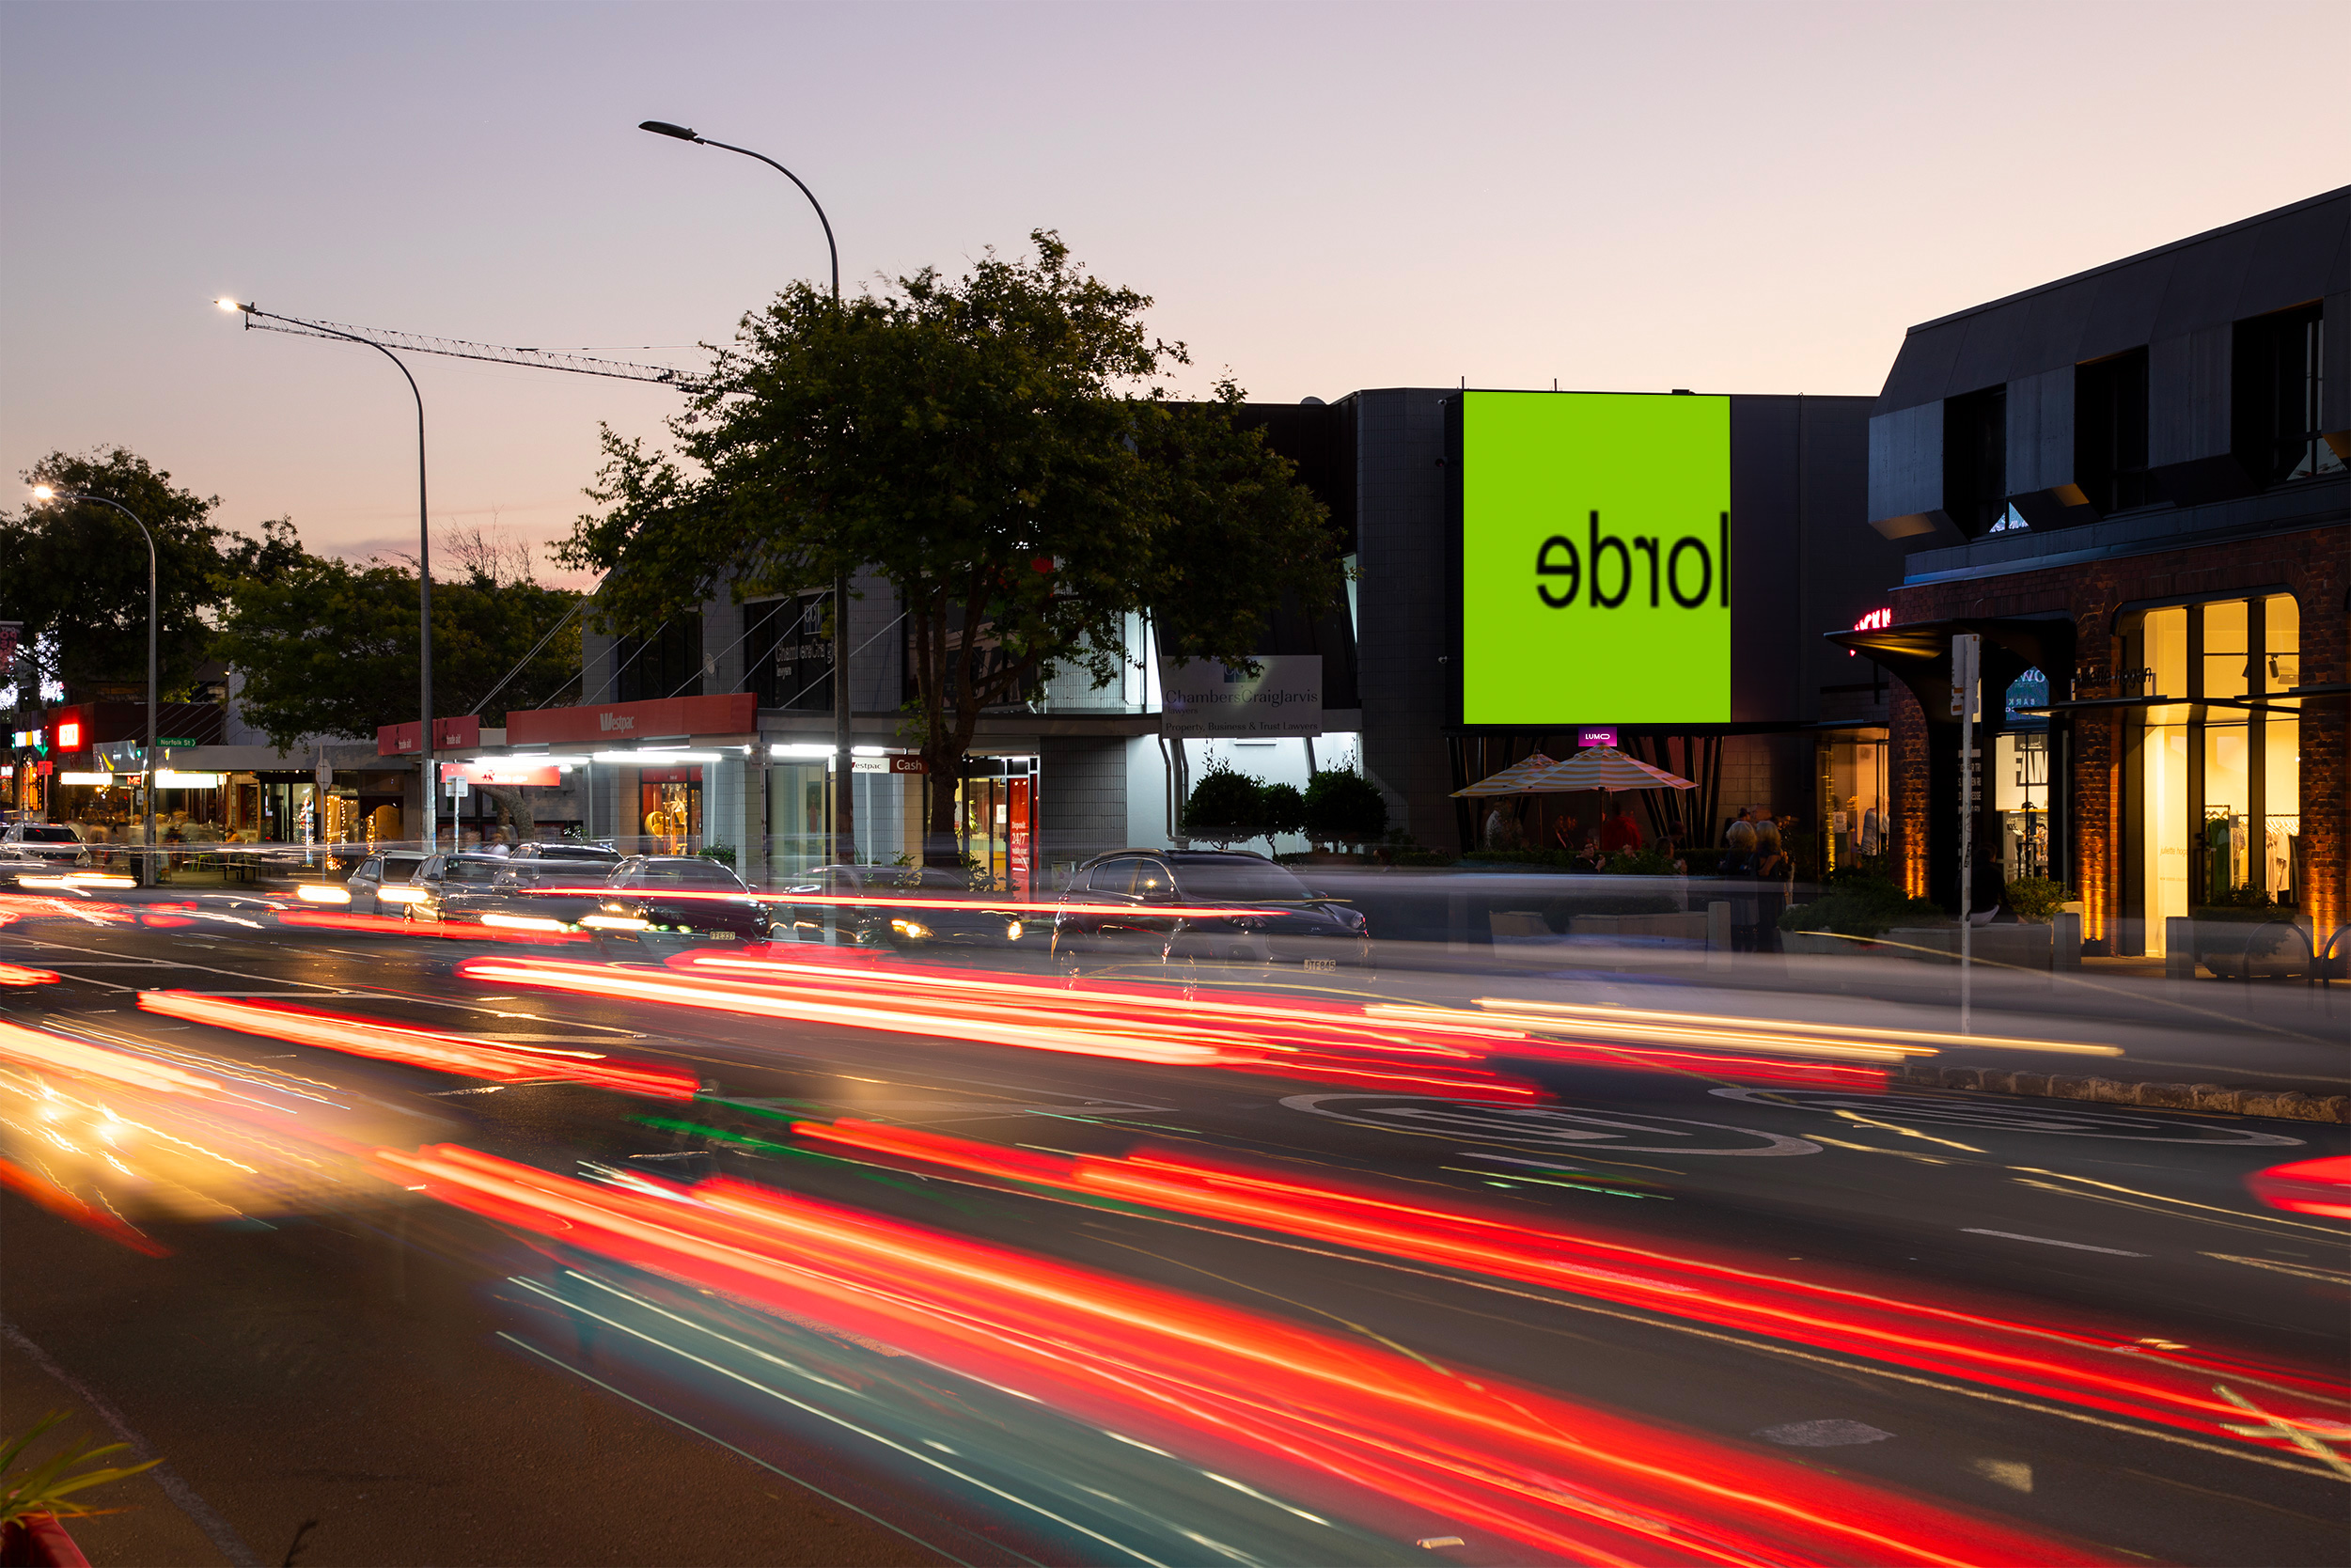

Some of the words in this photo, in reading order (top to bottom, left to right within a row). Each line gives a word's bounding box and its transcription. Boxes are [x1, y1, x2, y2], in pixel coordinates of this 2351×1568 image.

[1166, 689, 1318, 707] ChambersCraigJarvis
[1168, 707, 1199, 716] lawyers
[600, 713, 635, 733] Westpac
[1166, 722, 1205, 733] Property,
[1208, 722, 1246, 730] Business
[1248, 722, 1256, 730] &
[1260, 721, 1280, 730] Trust
[1283, 721, 1318, 732] Lawyers
[897, 759, 922, 771] Cash
[1011, 832, 1026, 845] 24/7
[1305, 961, 1335, 971] JTF845
